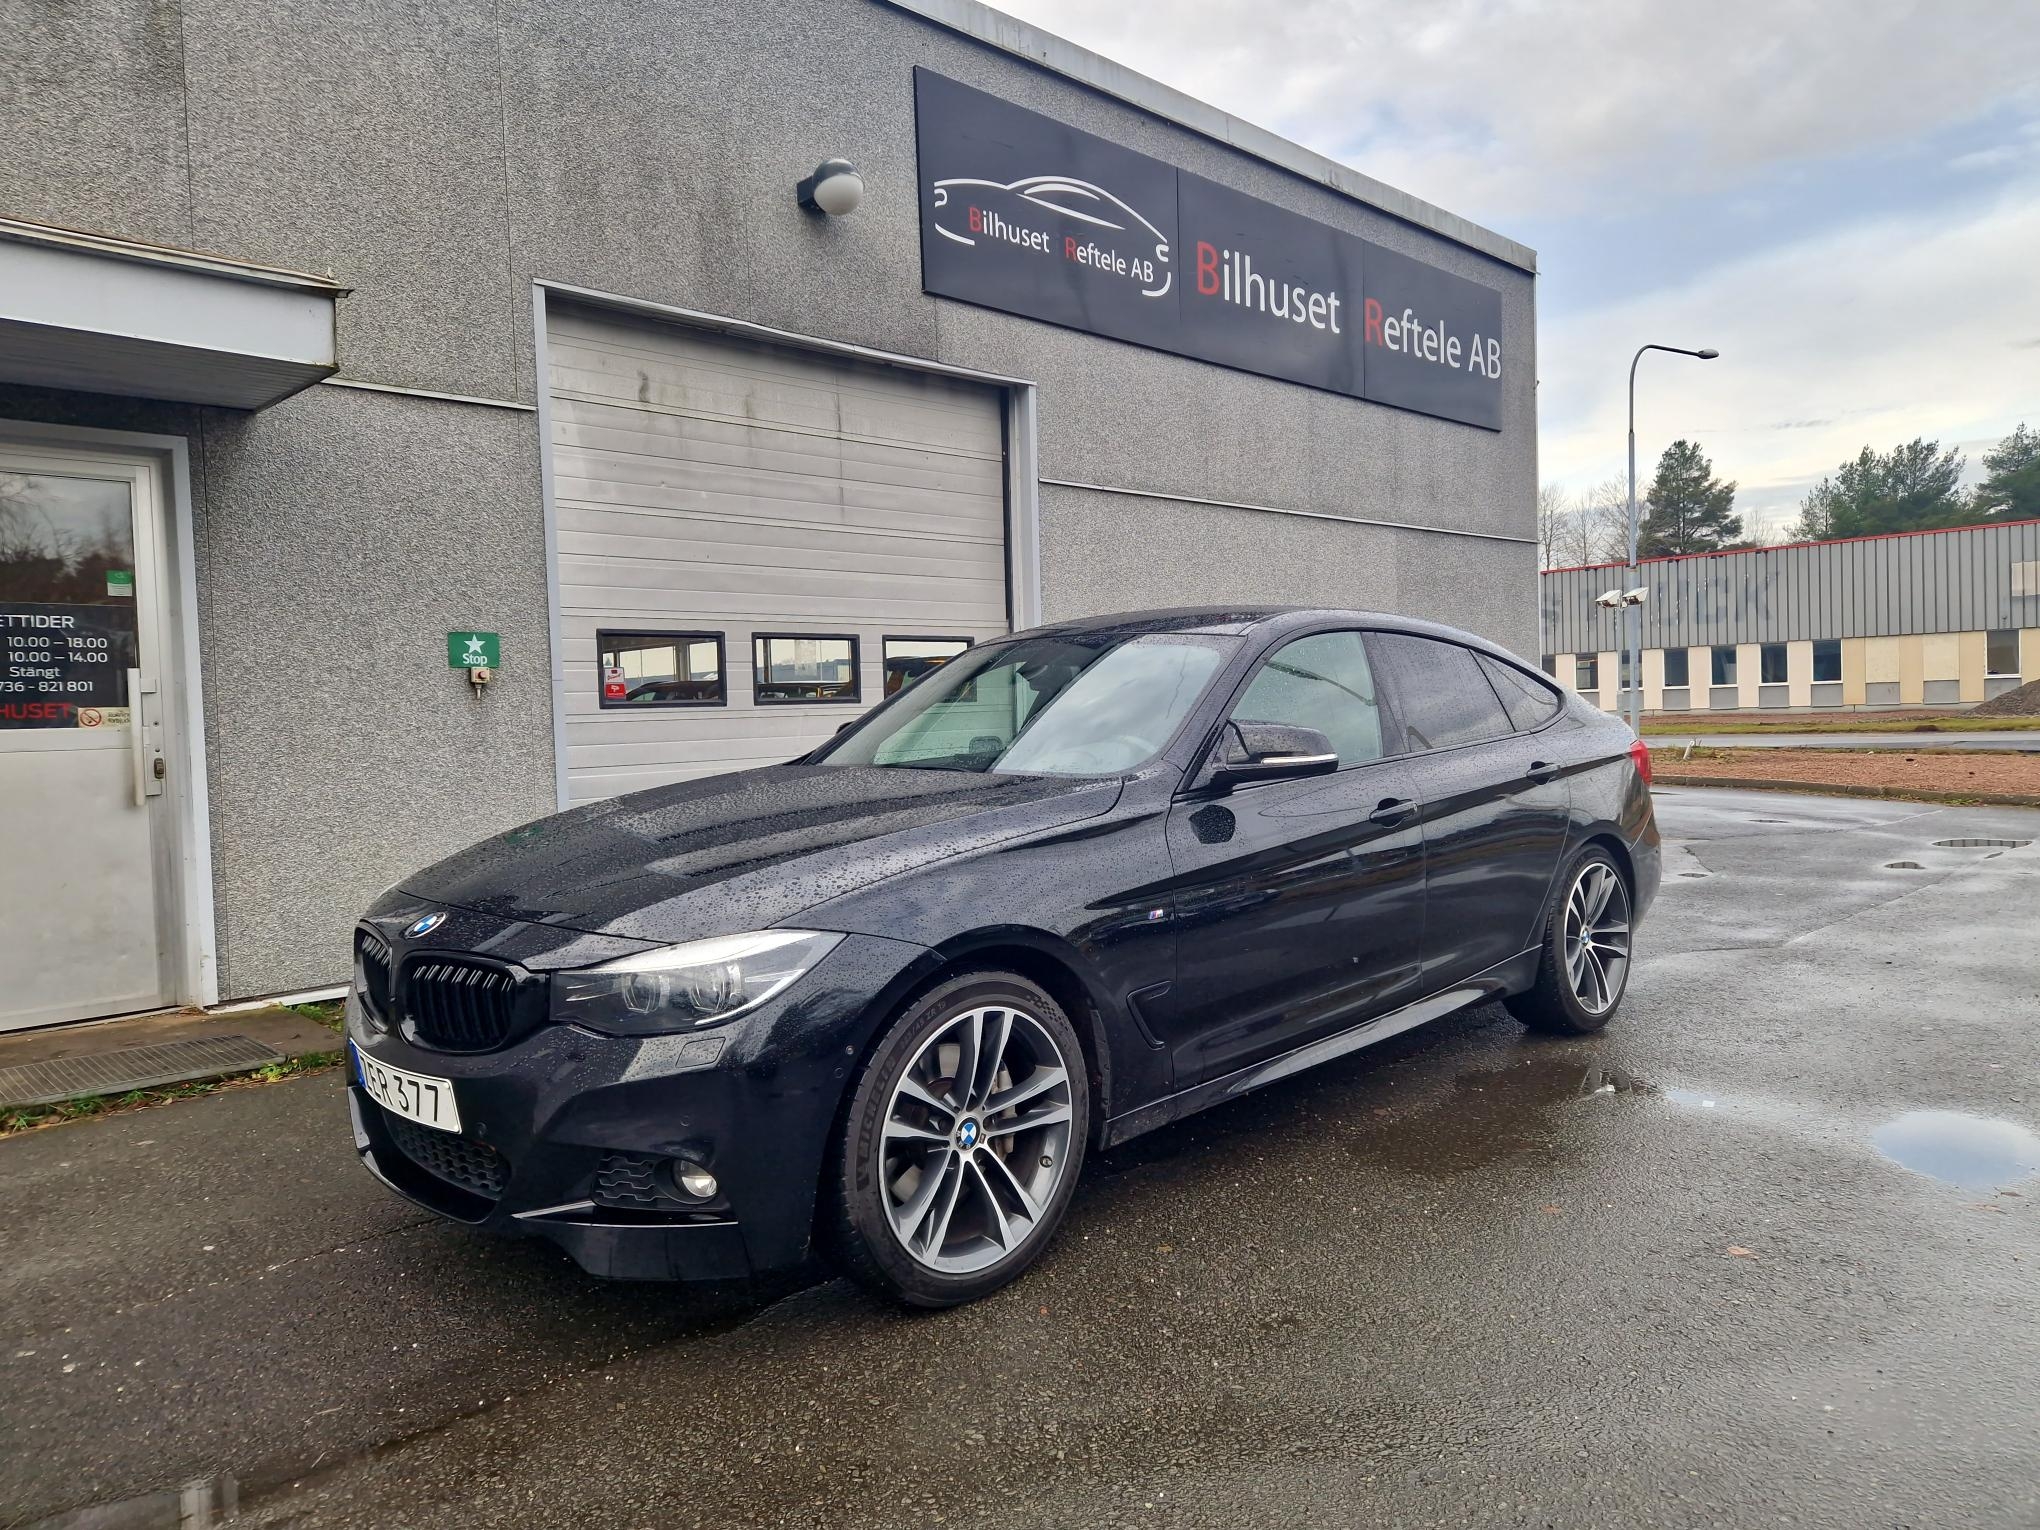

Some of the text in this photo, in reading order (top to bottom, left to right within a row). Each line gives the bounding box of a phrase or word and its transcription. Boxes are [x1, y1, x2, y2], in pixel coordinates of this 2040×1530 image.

[969, 206, 1154, 283] Bilhuset Reftele AB
[1196, 240, 1501, 379] Bilhuset Reftele AB
[7, 636, 50, 648] 10.00
[66, 637, 108, 648] 18.00
[8, 651, 51, 663] 10.00
[68, 652, 108, 663] 14.00
[462, 653, 488, 667] Stop
[9, 666, 61, 679] Stängt
[38, 681, 63, 692] 821
[67, 681, 93, 692] 801
[360, 1055, 438, 1122] ZER 377
